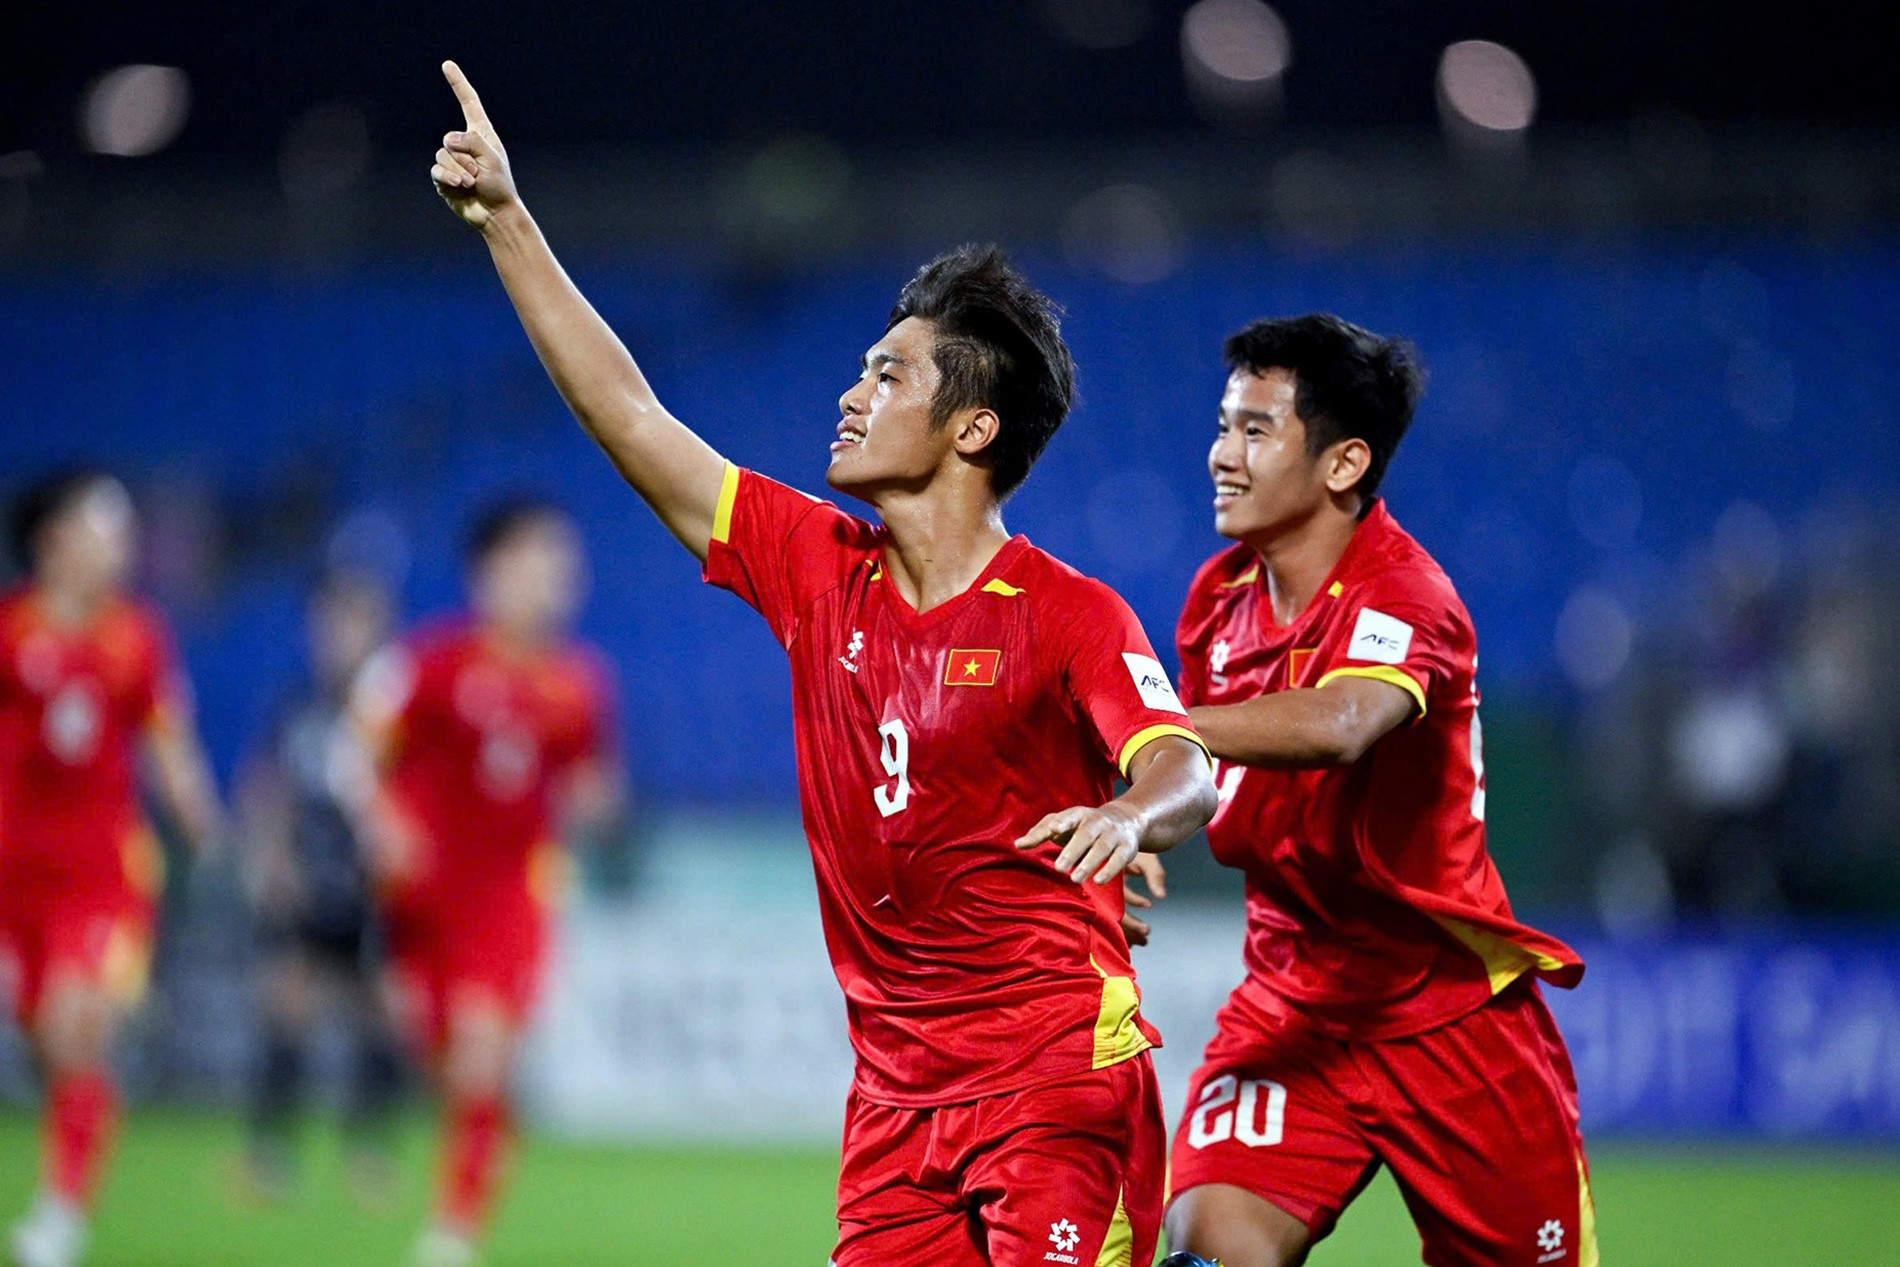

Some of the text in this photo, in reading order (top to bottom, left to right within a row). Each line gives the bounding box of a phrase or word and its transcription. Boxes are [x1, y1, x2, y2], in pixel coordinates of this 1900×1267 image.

[1140, 674, 1170, 693] AFC
[873, 718, 910, 818] 9
[1187, 1073, 1287, 1150] 20
